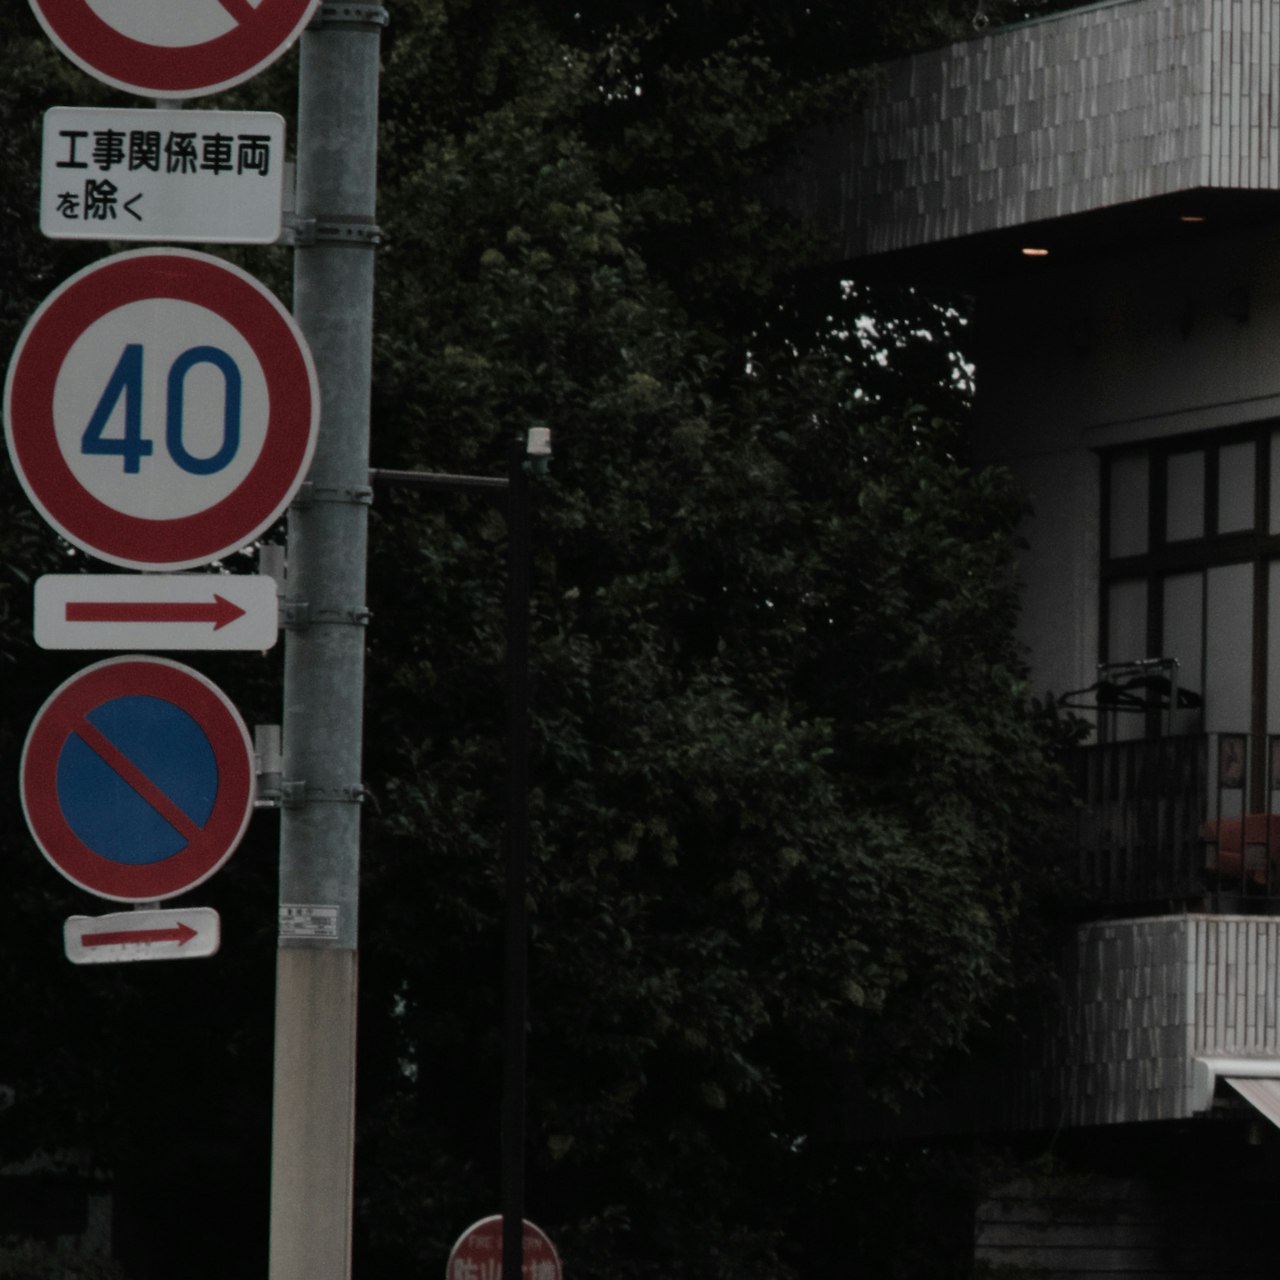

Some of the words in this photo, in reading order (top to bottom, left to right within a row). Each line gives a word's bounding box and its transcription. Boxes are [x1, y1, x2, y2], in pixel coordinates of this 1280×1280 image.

[56, 129, 271, 177] 工事関係車両
[56, 179, 143, 221] を除く
[81, 343, 242, 476] 40
